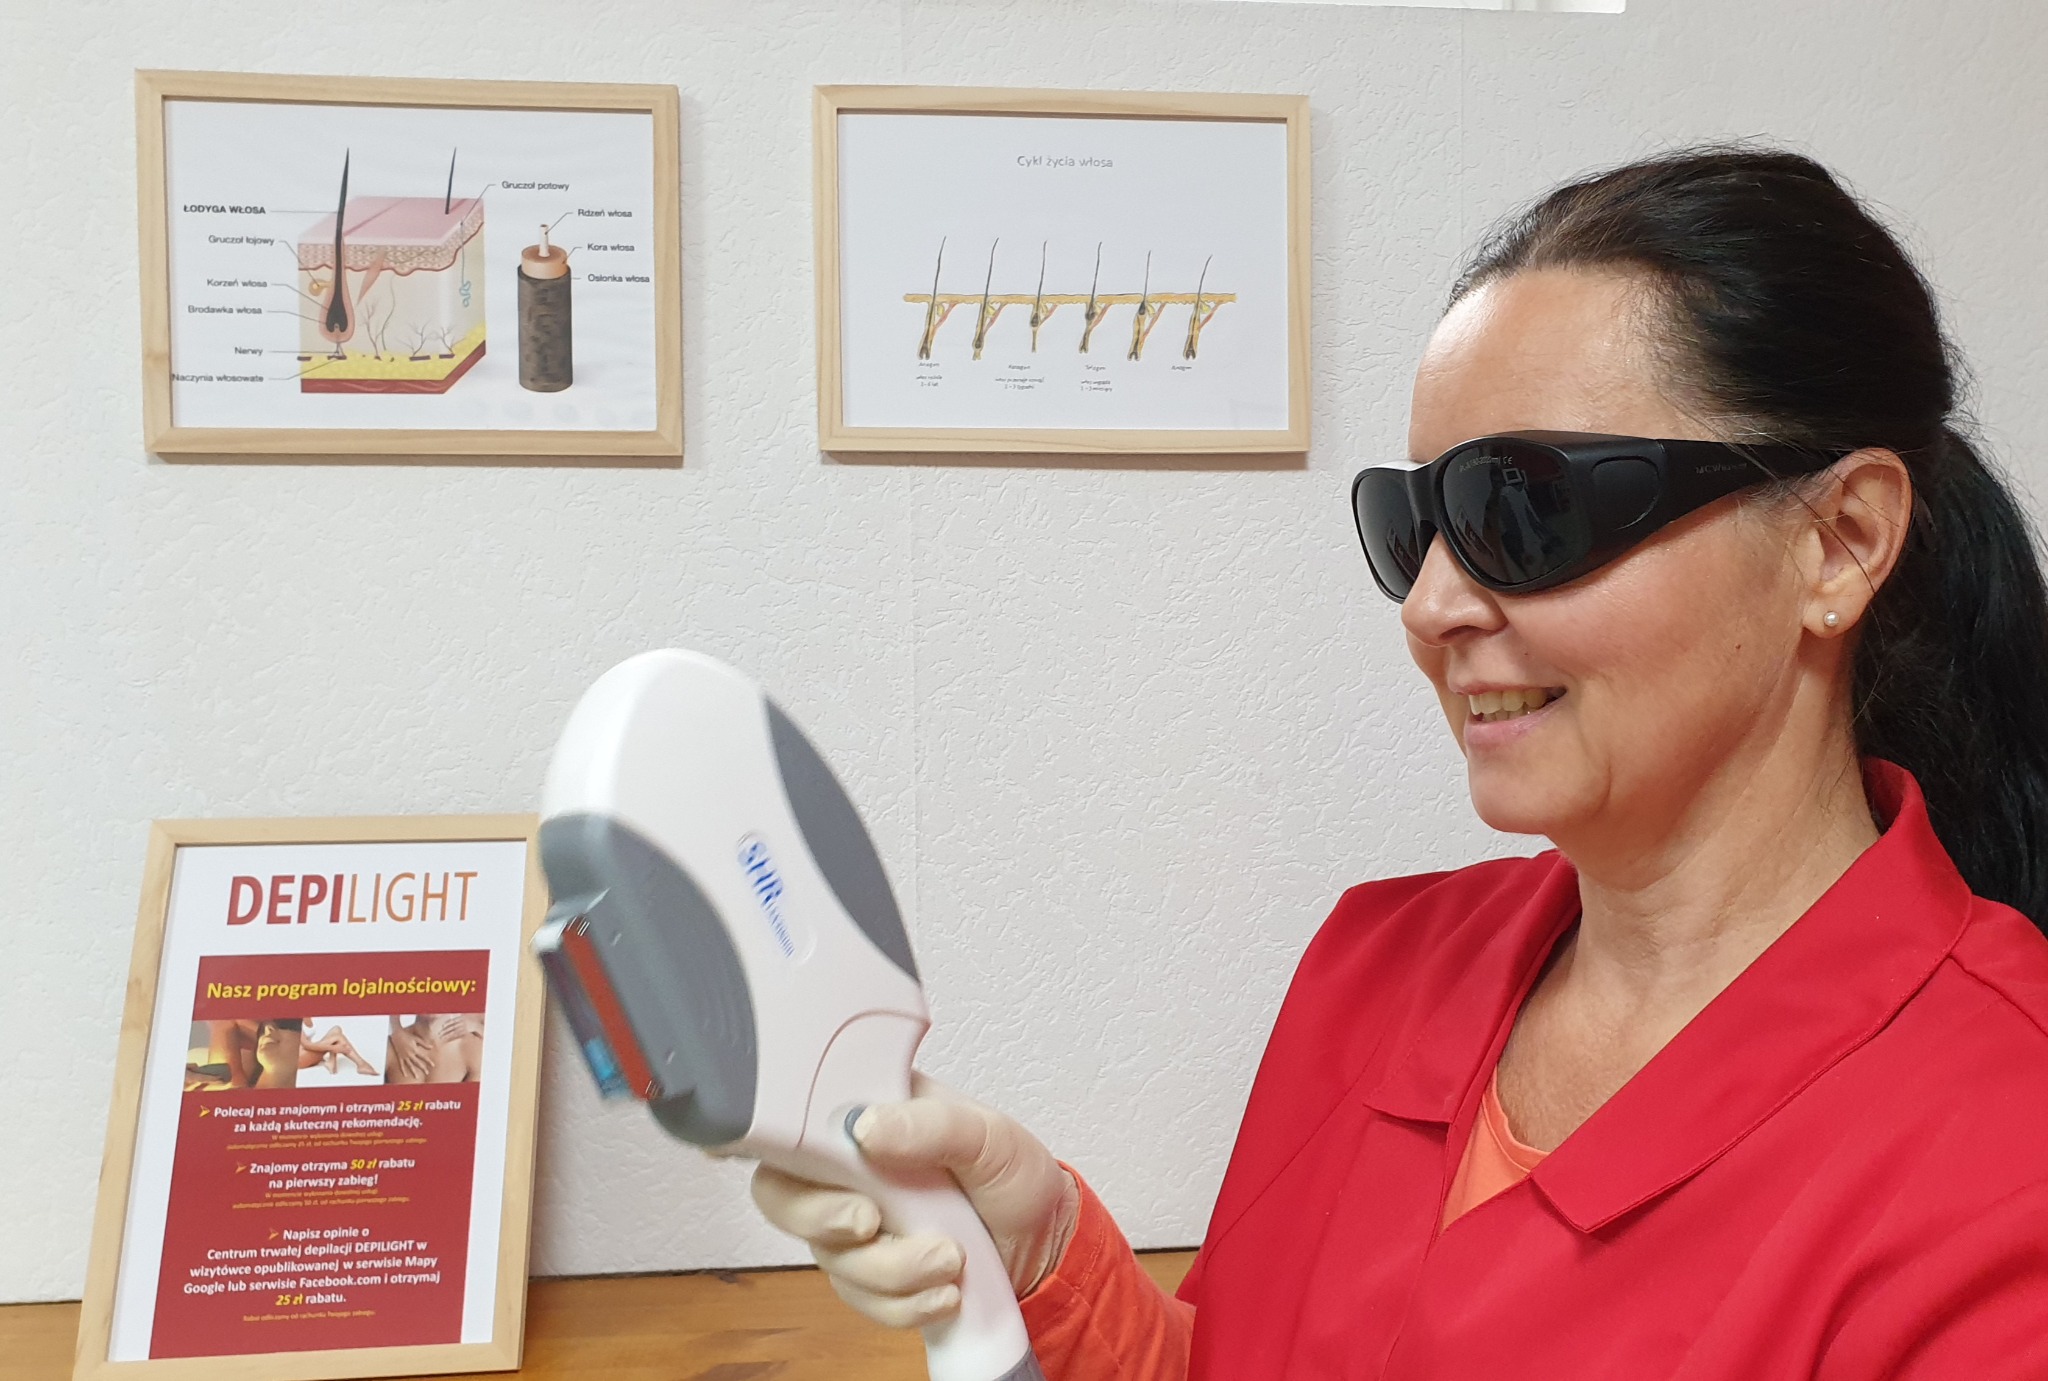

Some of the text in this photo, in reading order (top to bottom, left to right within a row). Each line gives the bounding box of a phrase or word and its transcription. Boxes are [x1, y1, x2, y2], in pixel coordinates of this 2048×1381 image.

[1017, 155, 1113, 168] Cykl życia włosa
[538, 182, 570, 192] potowy
[184, 204, 266, 214] ŁODYGA WŁOSA
[578, 208, 605, 217] Rdzeń
[587, 243, 608, 251] Kora
[207, 278, 238, 287] Korzeń
[188, 305, 233, 314] Brodawka
[235, 347, 263, 356] Nerwy
[172, 374, 214, 384] Naczynia
[227, 872, 478, 925] DEPILIGHT
[207, 976, 476, 1000] Nasz program lojalnościowy:
[214, 1106, 254, 1118] Polecaj
[257, 1107, 276, 1116] nas
[280, 1104, 337, 1116] znajomym
[346, 1102, 395, 1114] otrzymaj
[397, 1101, 411, 1111] 25
[413, 1100, 424, 1111] zł
[425, 1100, 461, 1110] rabatu
[234, 1116, 423, 1133] za każdą skuteczną rekomendację.
[250, 1158, 415, 1175] Znajomy otrzyma 50 zł rabatu
[269, 1174, 378, 1190] na pierwszy zabieg!
[283, 1227, 370, 1241] Napisz opinie o
[207, 1240, 427, 1260] Centrum trwałej depilacji DEPILIGHT w
[190, 1256, 438, 1278] wizytówce opublikowanej w serwisie Mapy
[184, 1282, 225, 1295] Google
[228, 1280, 246, 1292] lub
[249, 1278, 296, 1291] serwisie
[300, 1275, 381, 1288] Facebook.com
[390, 1271, 440, 1284] otrzymaj
[275, 1293, 346, 1306] 25 zł rabatu.
